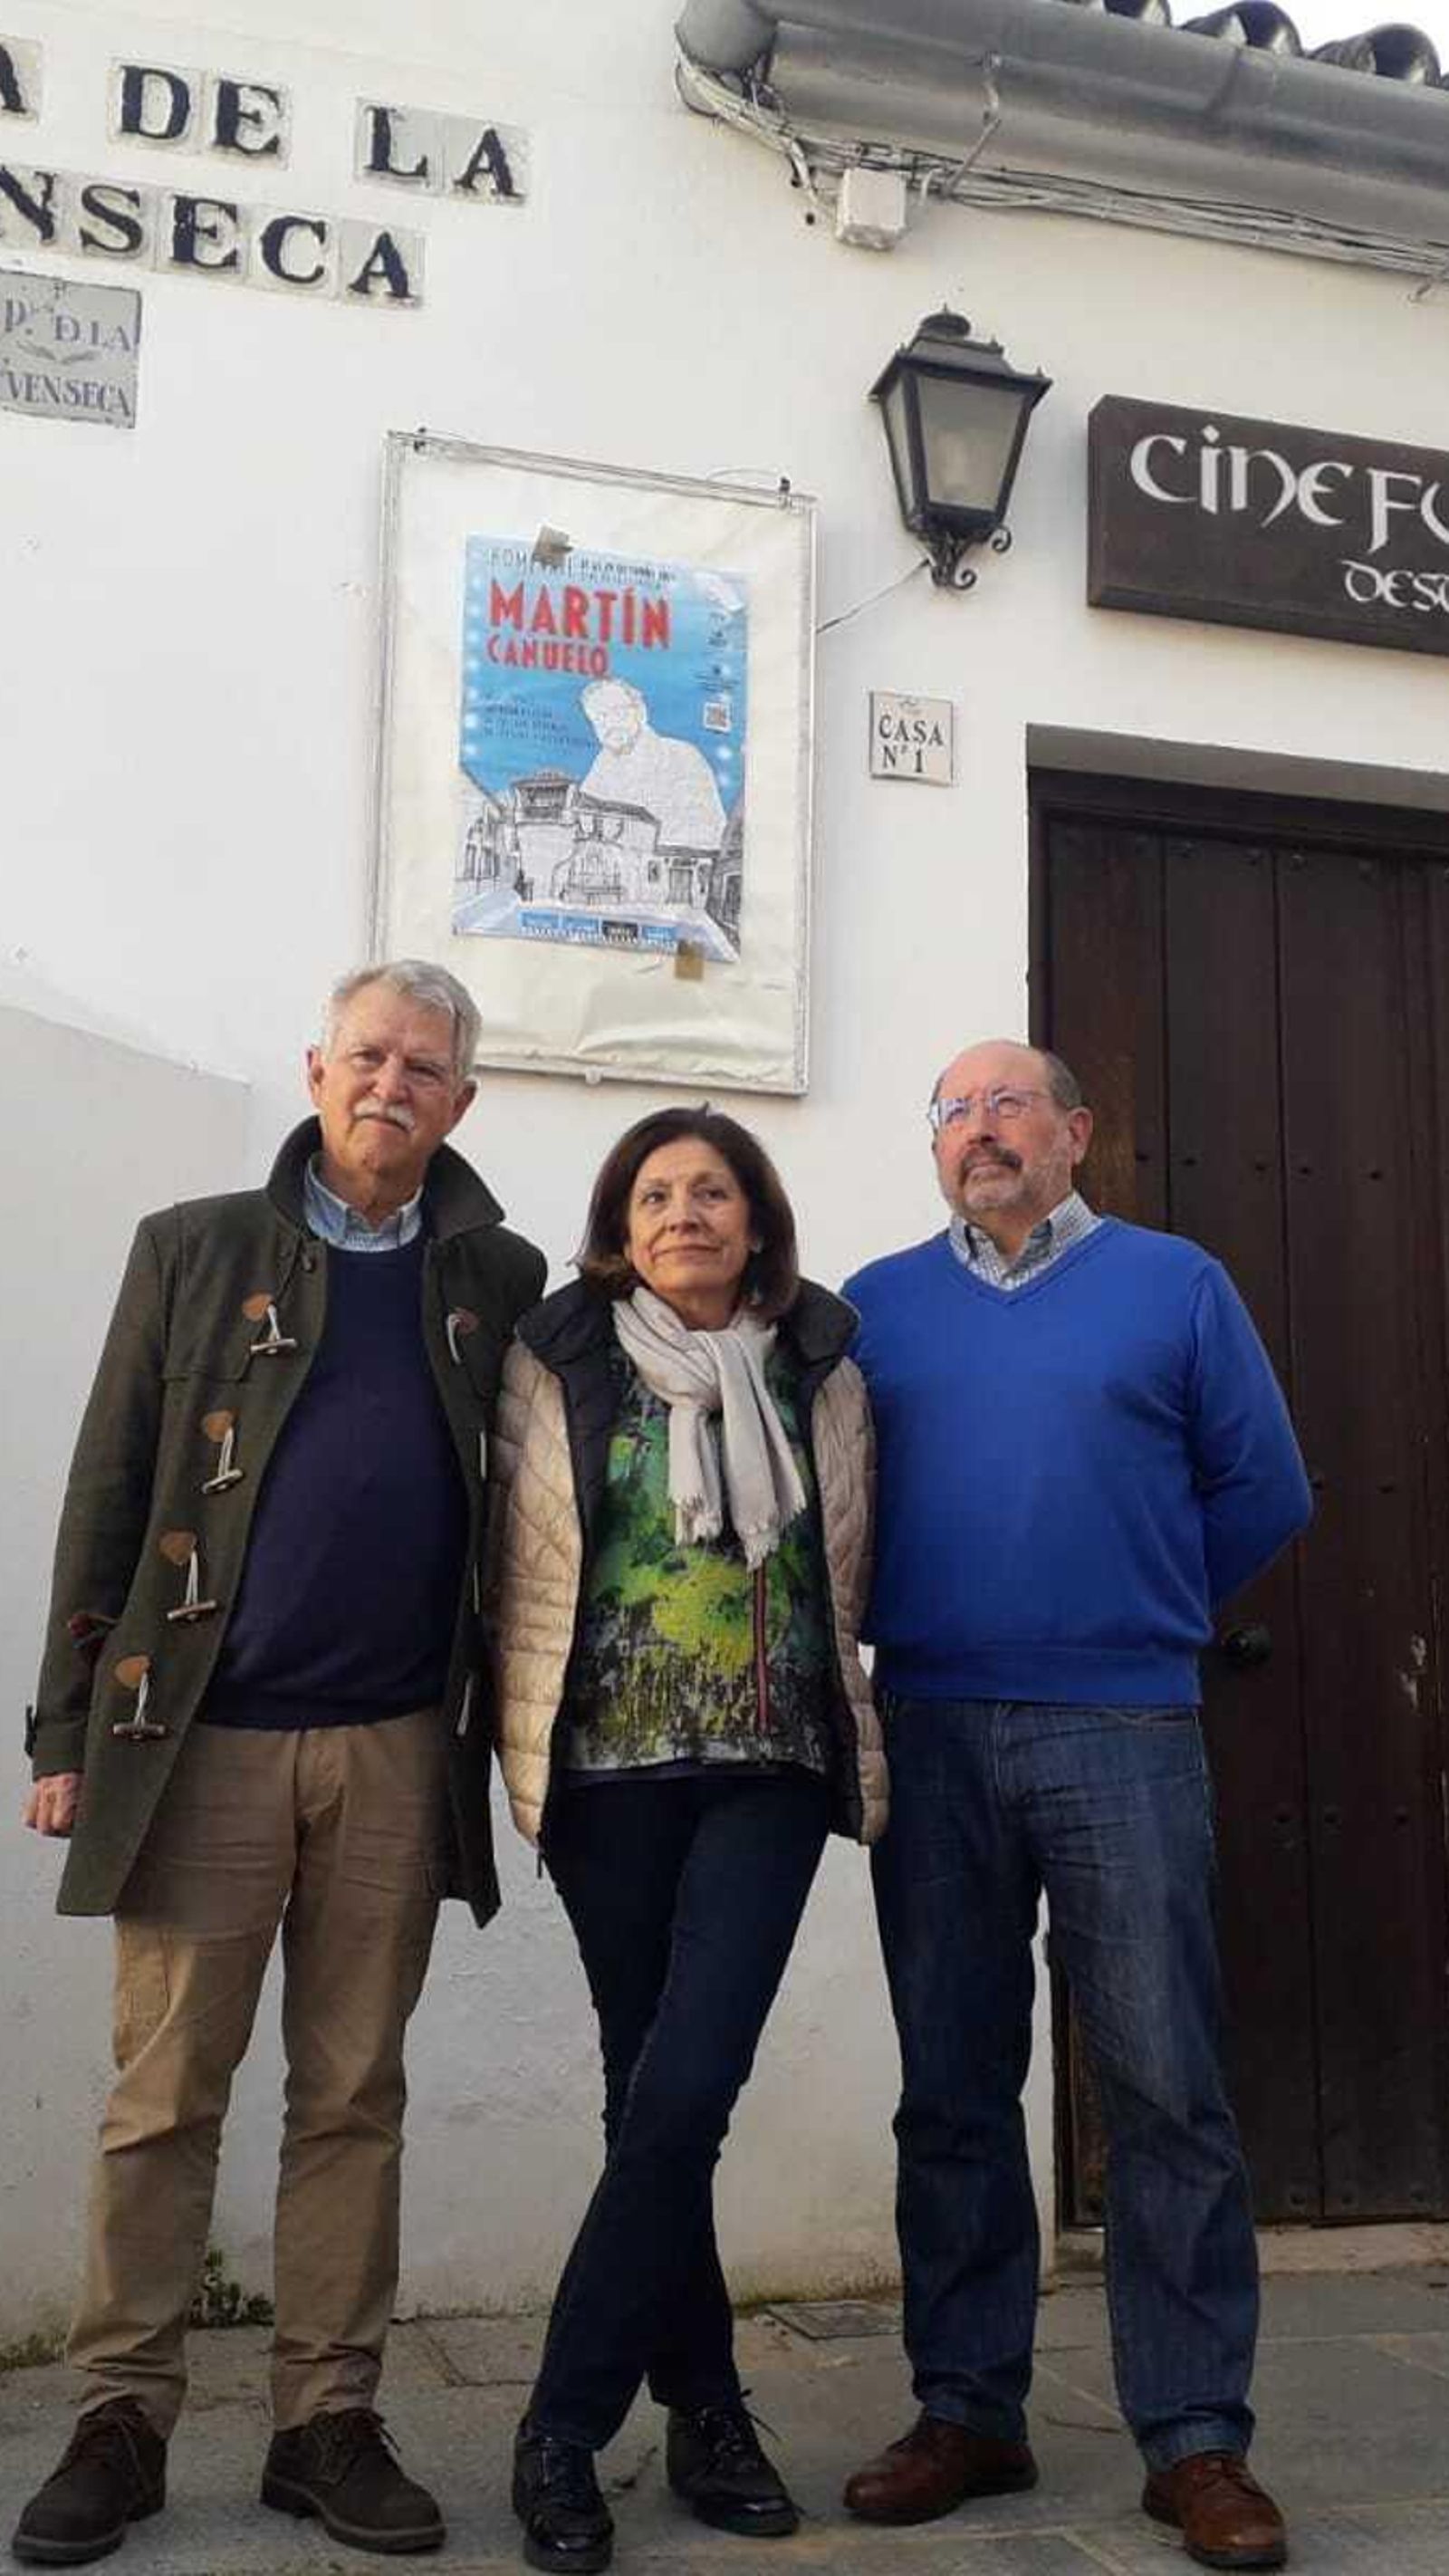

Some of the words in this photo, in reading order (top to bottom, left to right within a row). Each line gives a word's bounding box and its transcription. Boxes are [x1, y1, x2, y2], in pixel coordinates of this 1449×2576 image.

[120, 64, 280, 156] DE
[365, 105, 525, 197] LA
[0, 370, 131, 417] VENSECA
[489, 578, 671, 649] MARTÍN
[878, 714, 945, 746] CASA
[914, 749, 923, 774] 1
